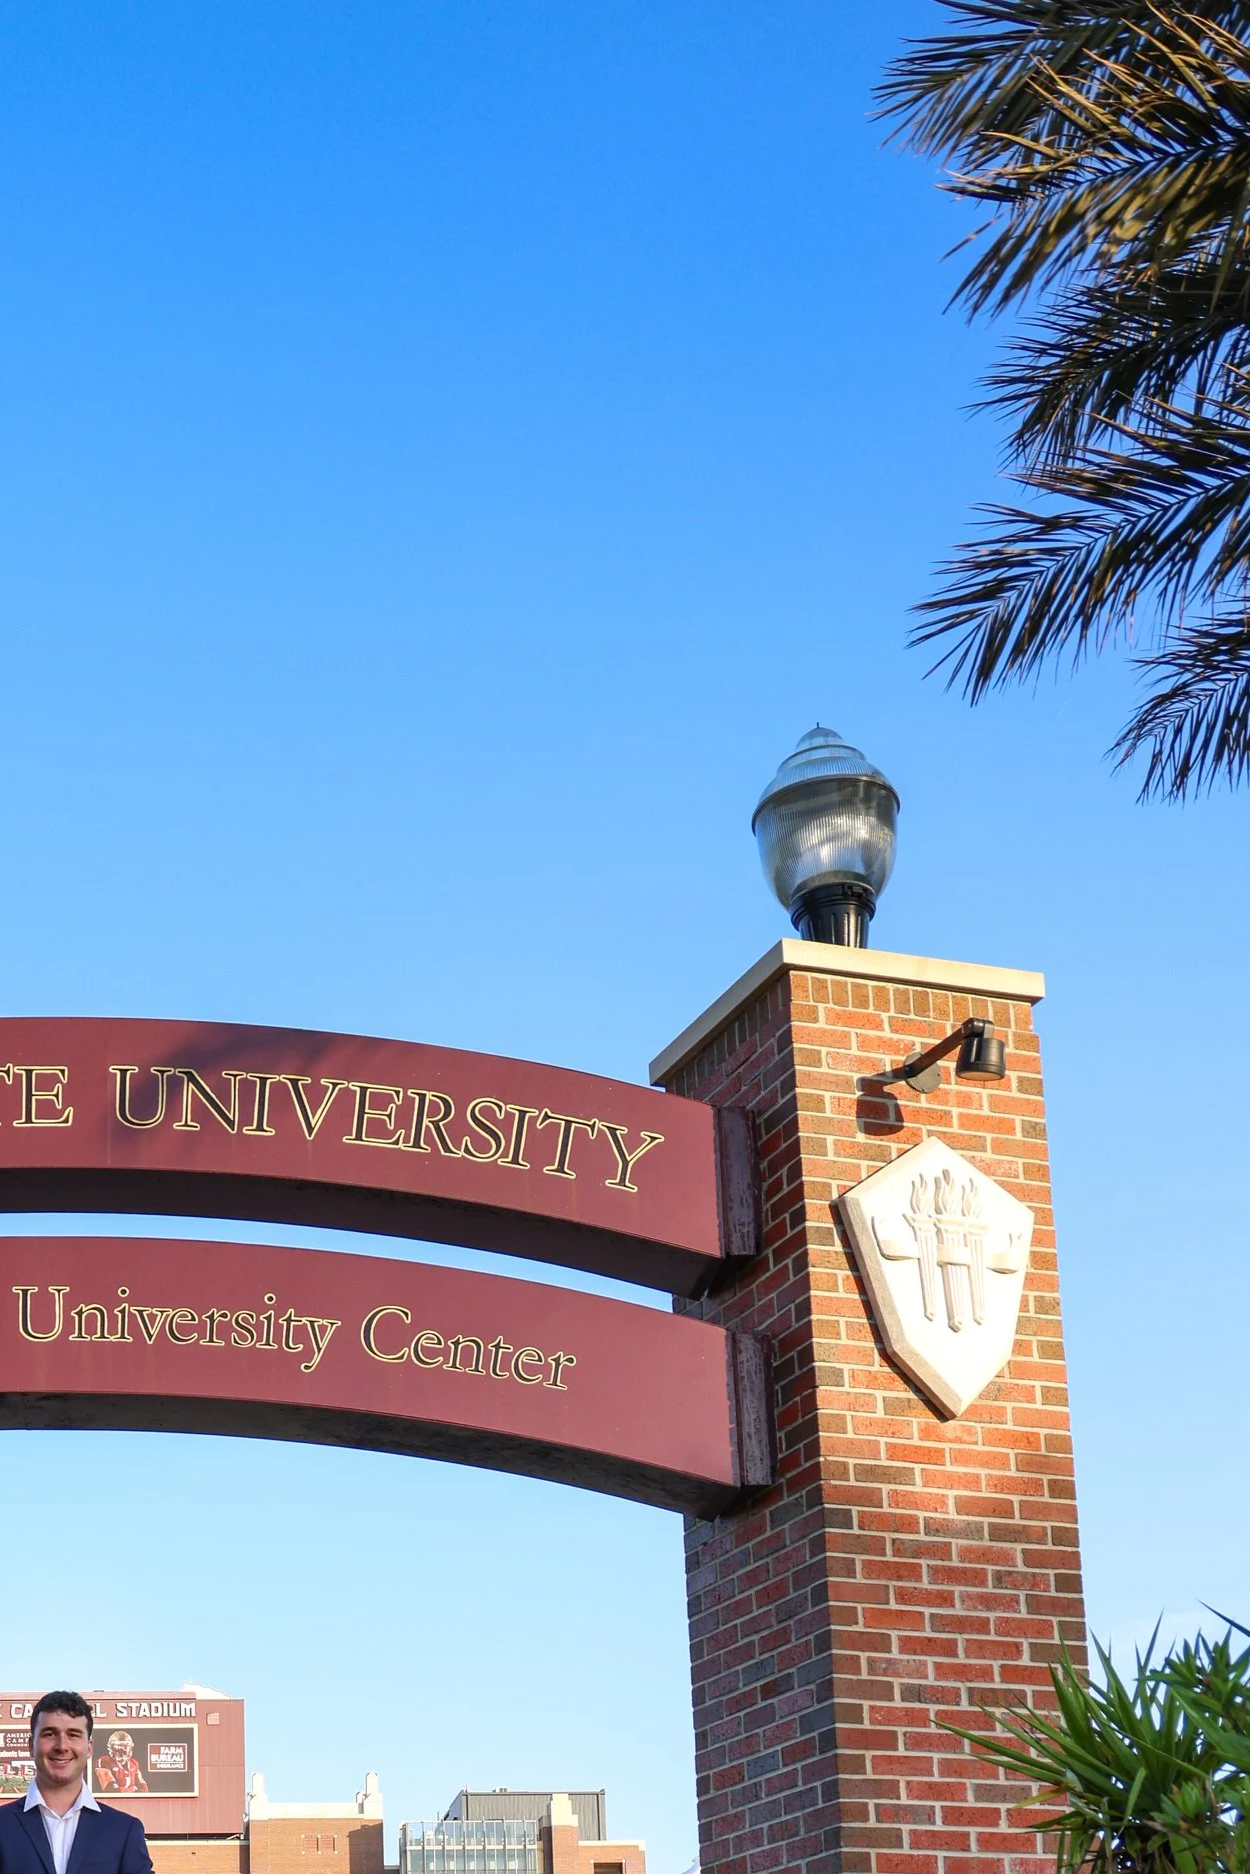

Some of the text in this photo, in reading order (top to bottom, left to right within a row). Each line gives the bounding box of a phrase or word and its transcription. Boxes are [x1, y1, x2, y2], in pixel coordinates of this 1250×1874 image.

[107, 1064, 665, 1194] UNIVERSITY
[11, 1285, 343, 1373] University
[359, 1304, 578, 1390] Center
[115, 1702, 196, 1718] STADIUM
[150, 1754, 184, 1762] BUREAU
[160, 1746, 184, 1754] FARM
